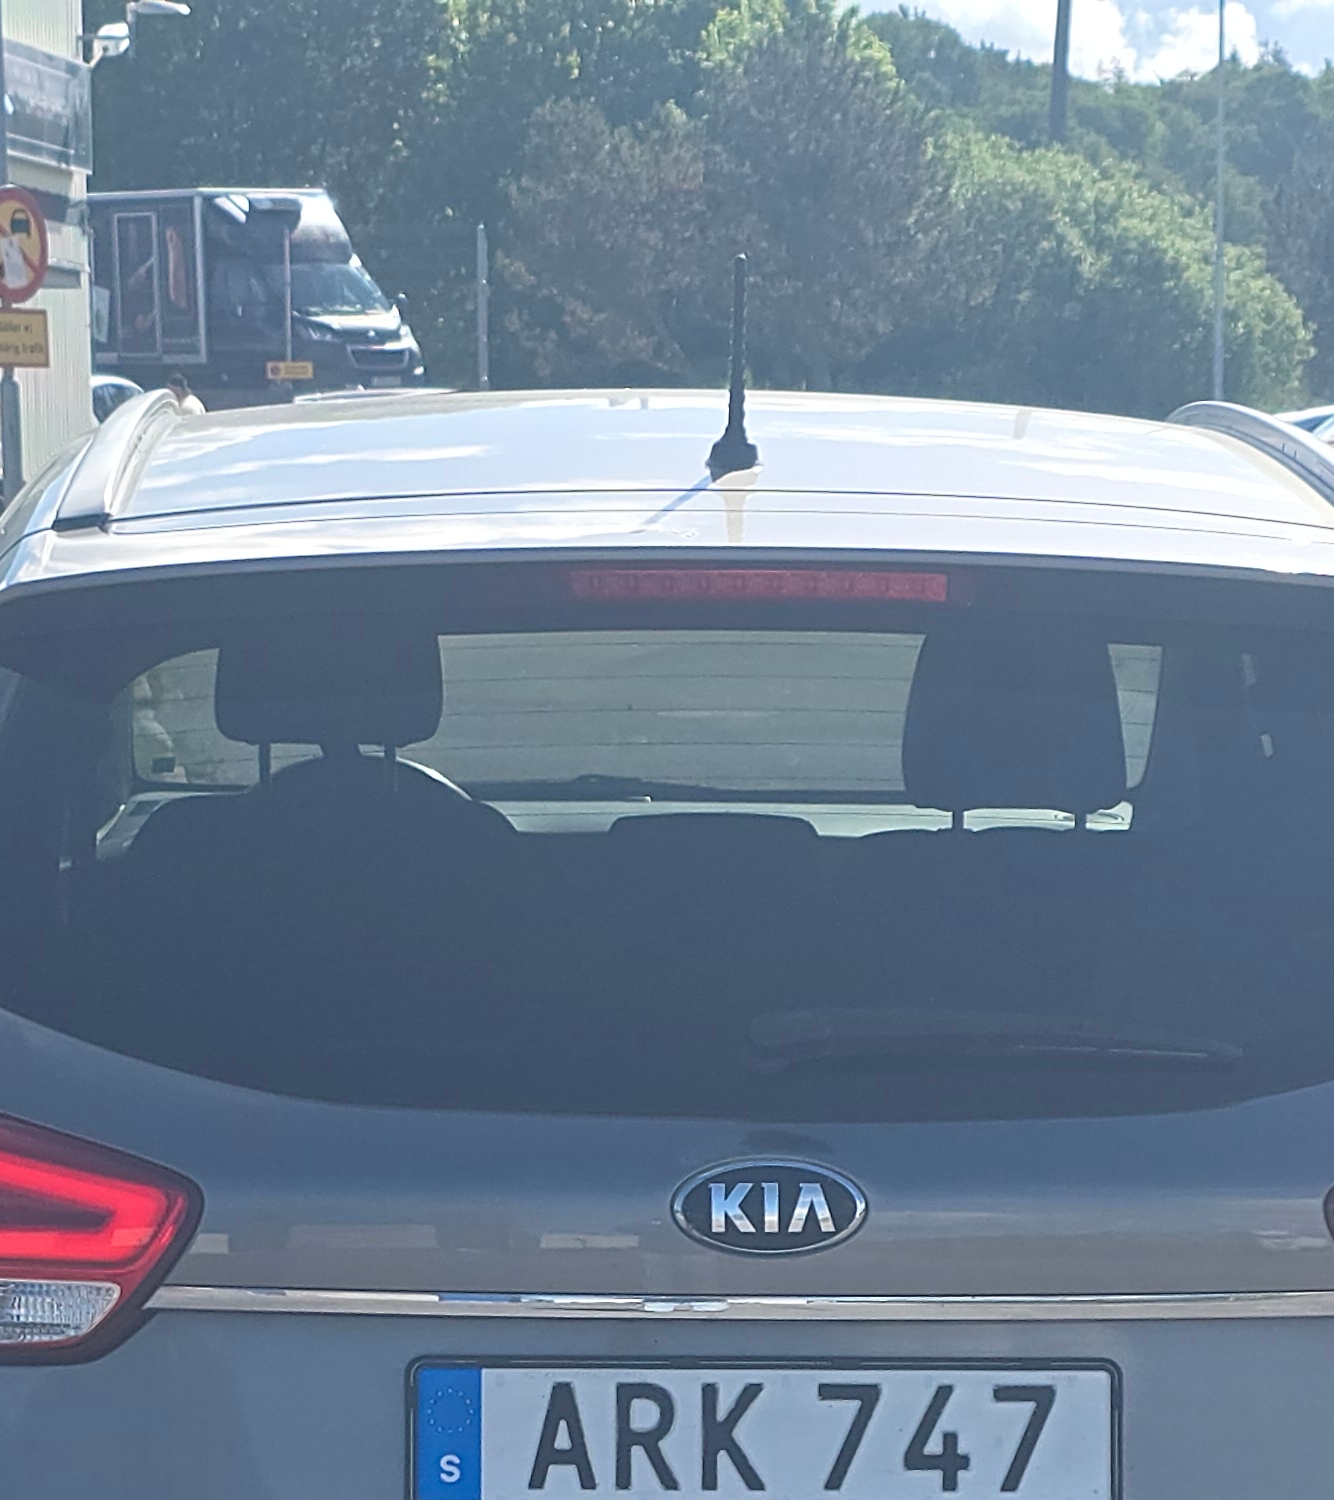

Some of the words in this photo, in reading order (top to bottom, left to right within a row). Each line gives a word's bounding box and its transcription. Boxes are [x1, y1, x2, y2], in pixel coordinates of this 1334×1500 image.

[708, 1182, 836, 1233] KIA
[527, 1381, 766, 1492] ARK
[817, 1382, 1058, 1493] 747
[439, 1453, 462, 1484] S
